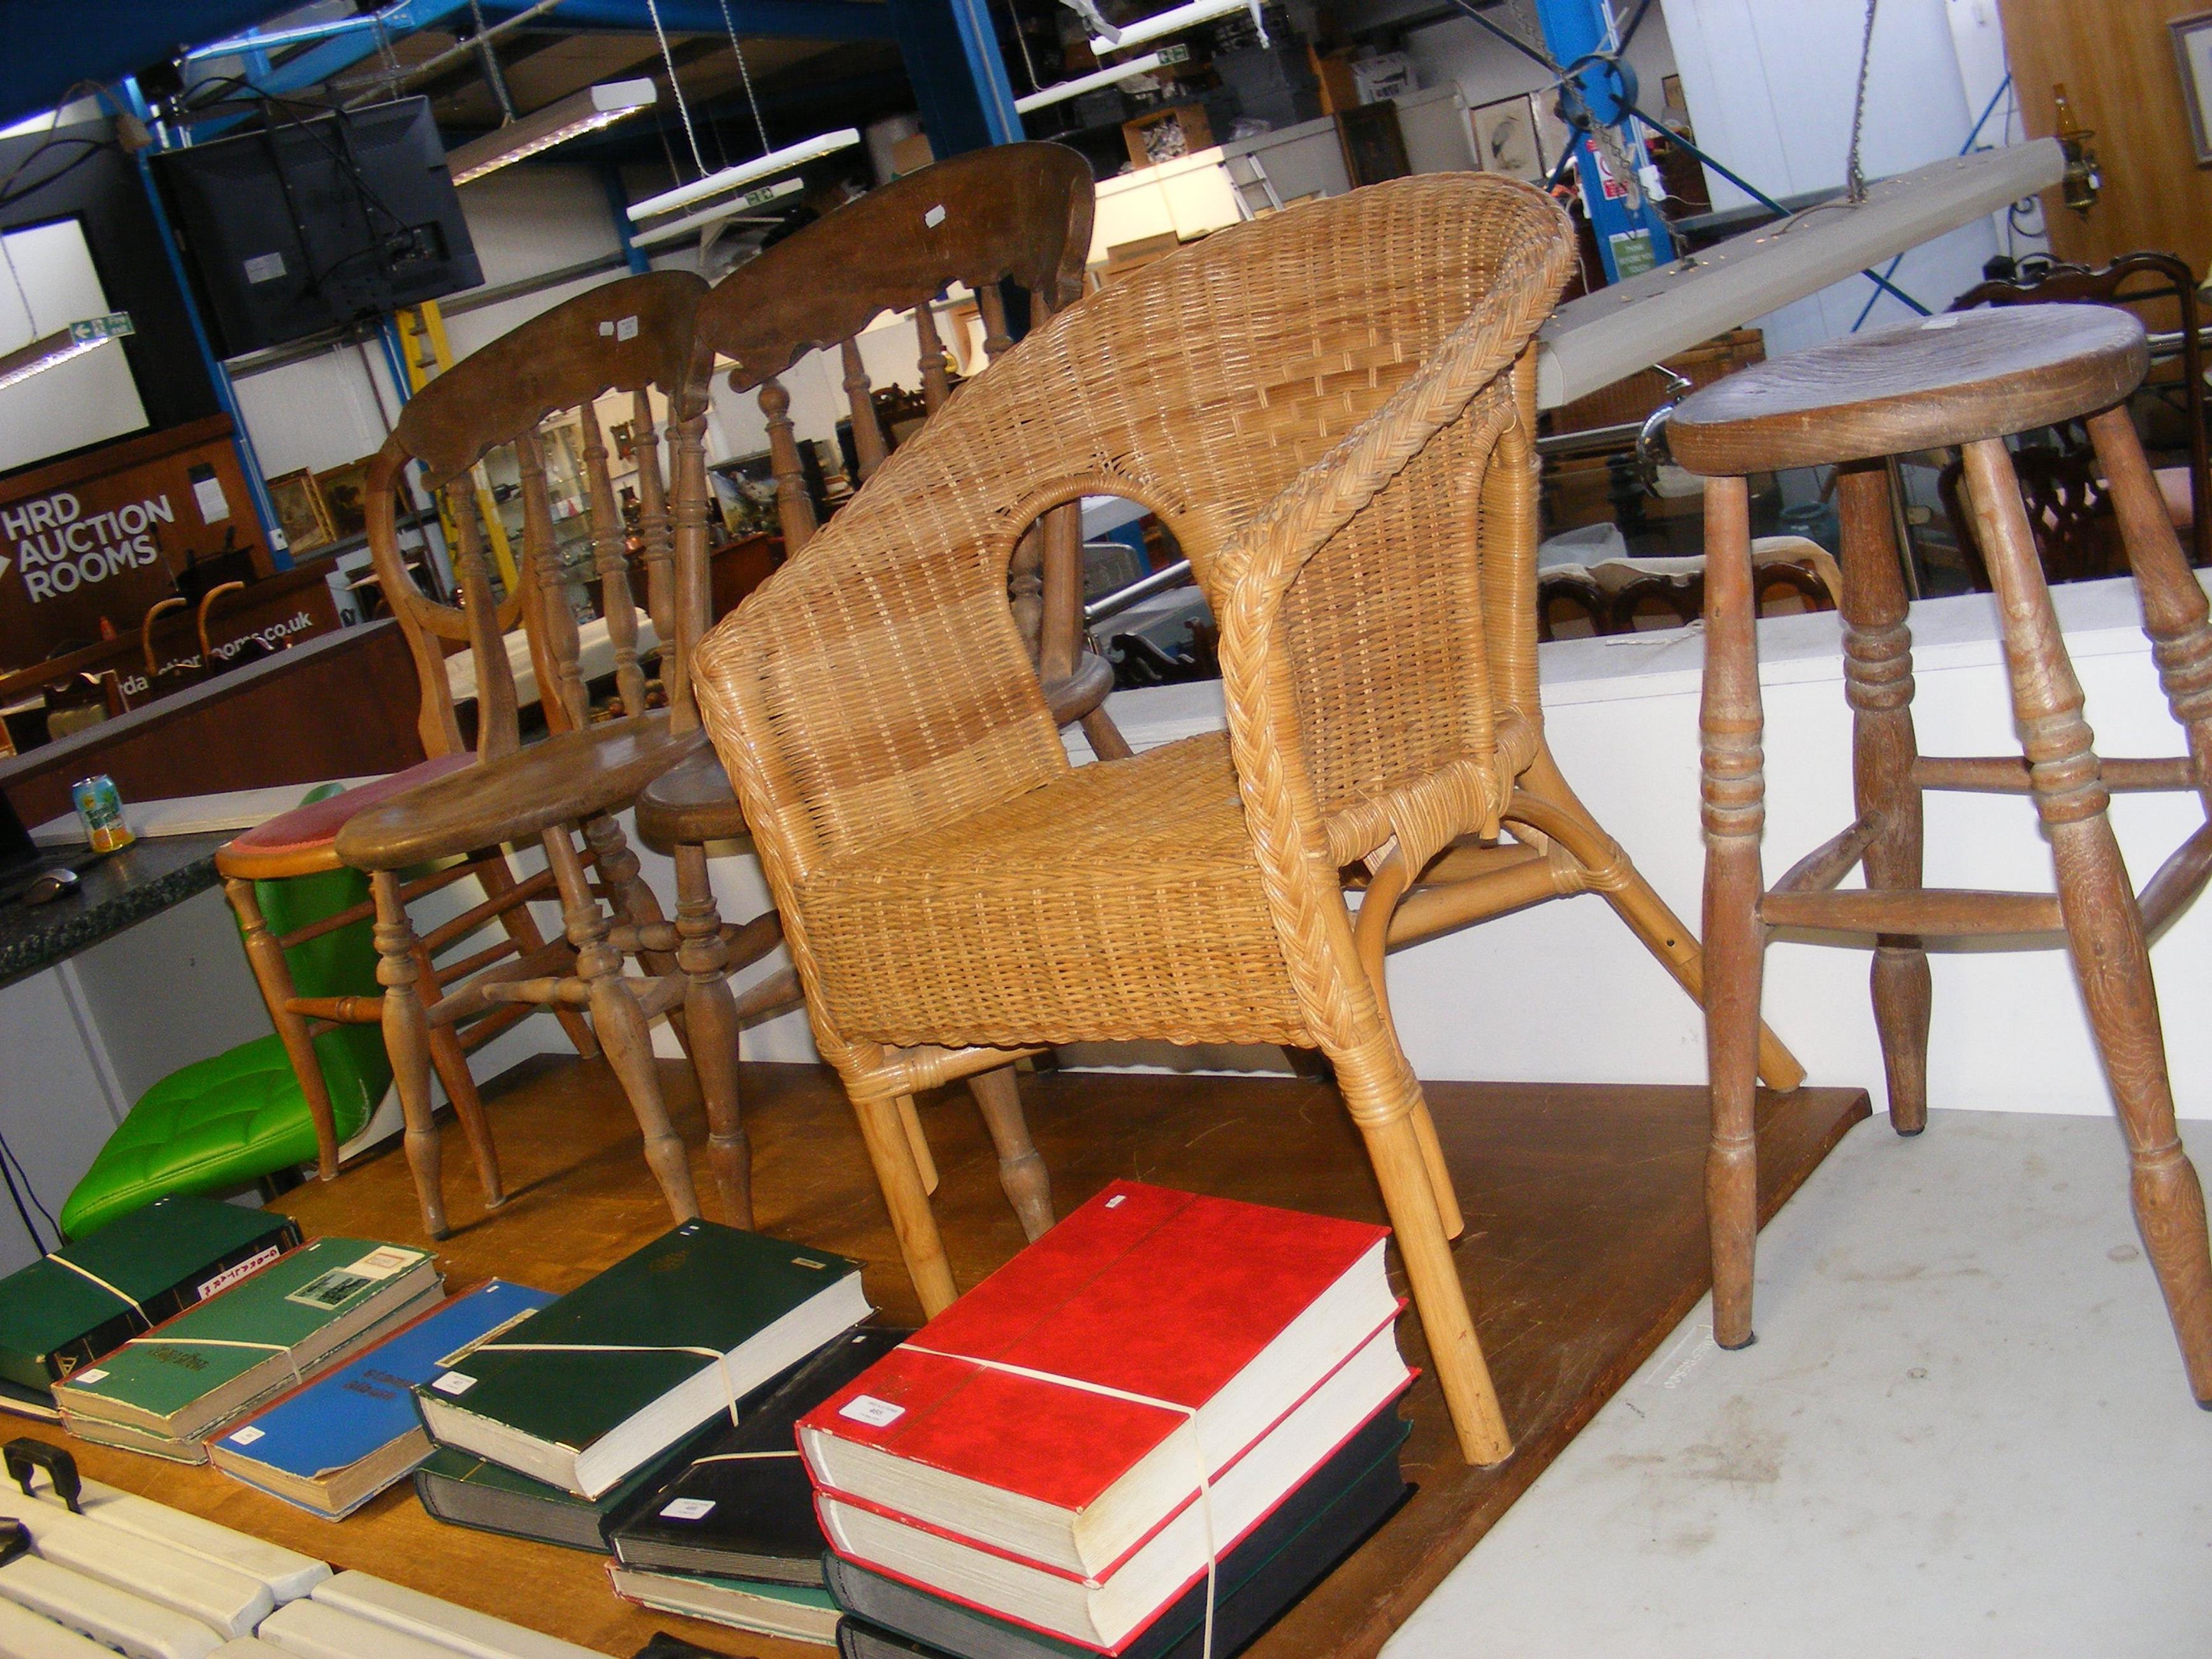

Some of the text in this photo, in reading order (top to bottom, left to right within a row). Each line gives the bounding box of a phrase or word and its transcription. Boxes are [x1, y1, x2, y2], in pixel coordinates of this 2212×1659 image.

[1, 493, 80, 540] HRD
[20, 495, 175, 572] AUCTION
[24, 535, 157, 603] ROOMS
[212, 1249, 277, 1289] GIBRALTAR
